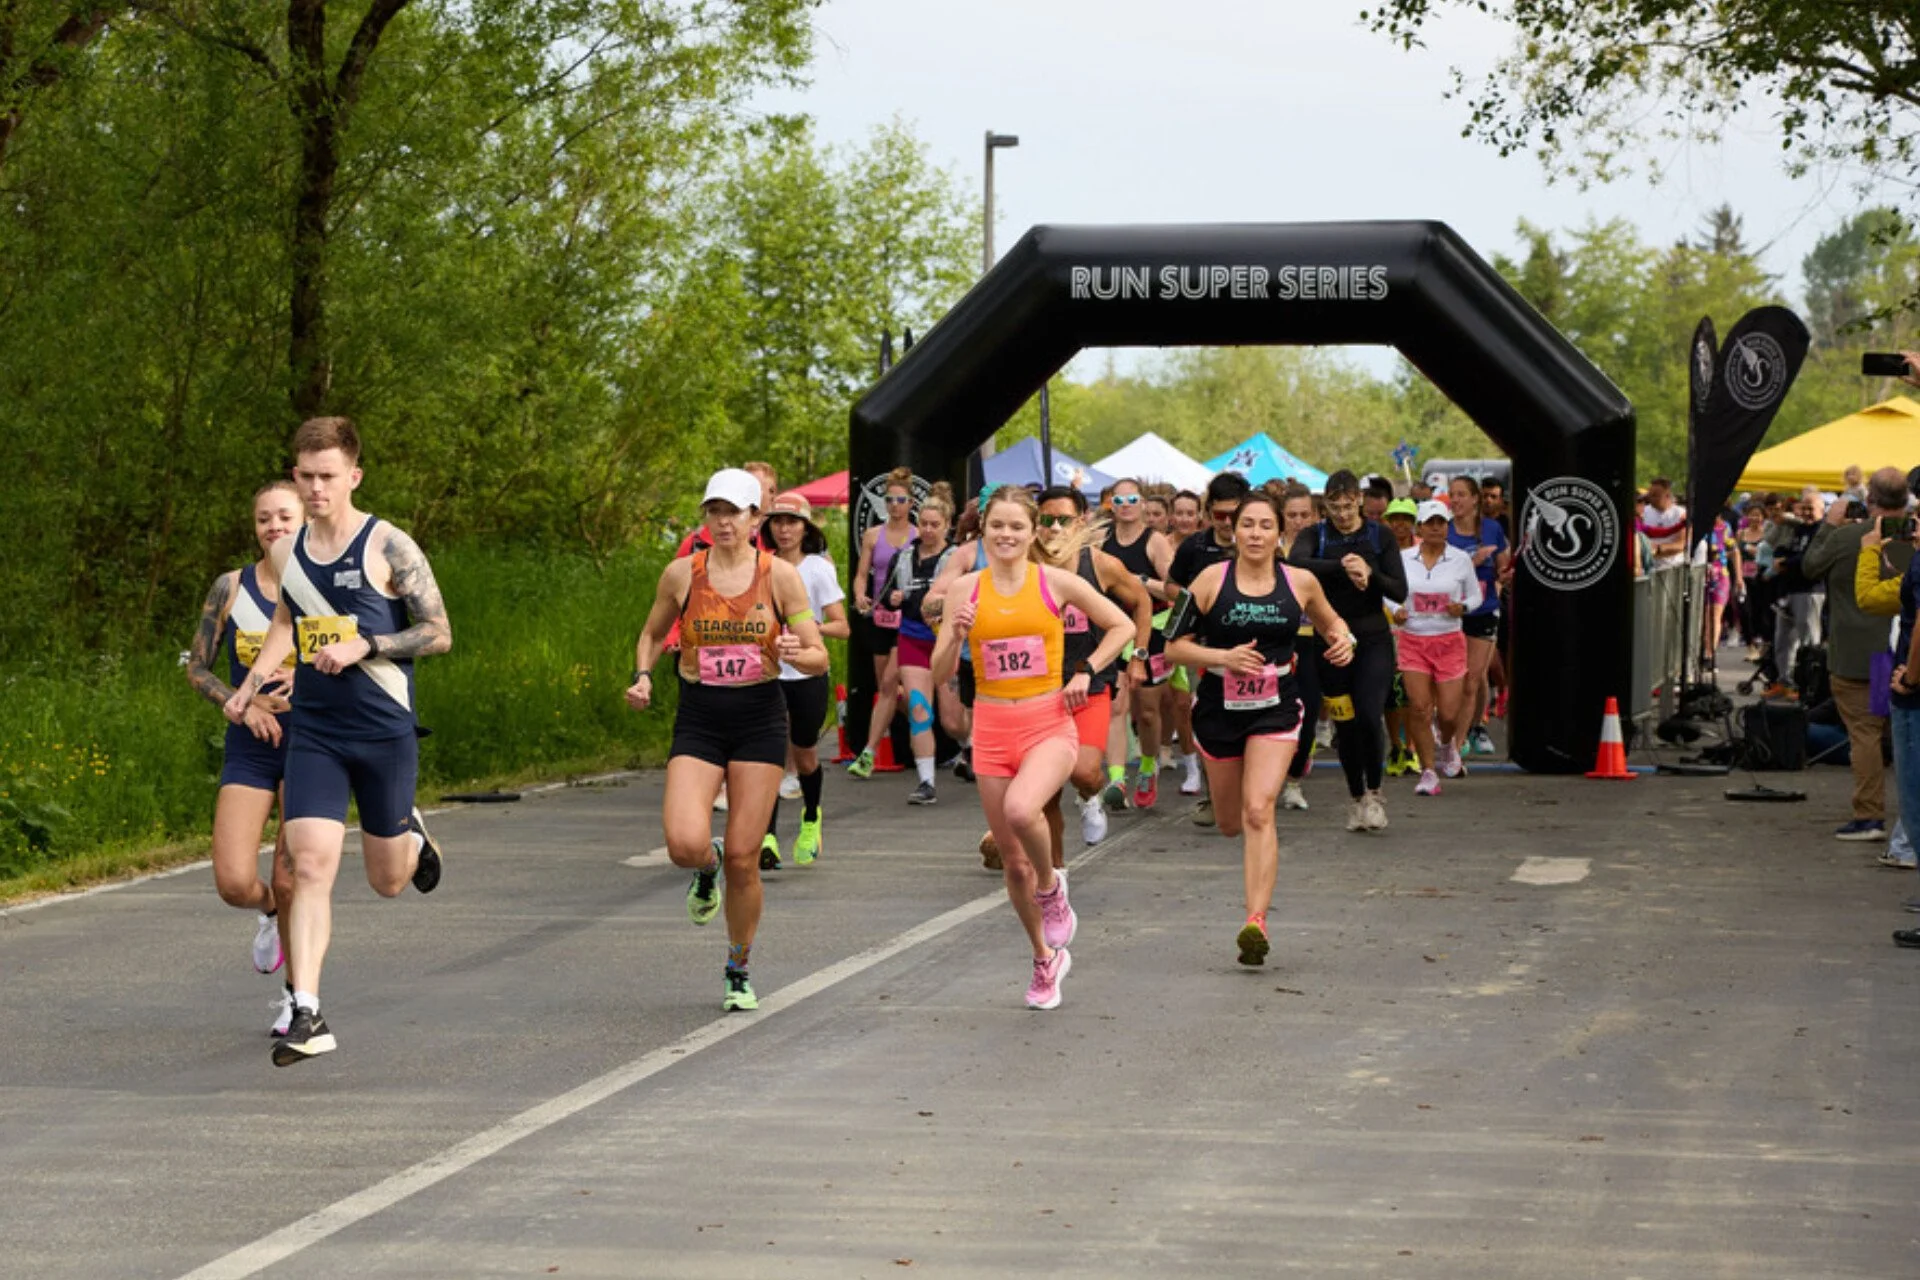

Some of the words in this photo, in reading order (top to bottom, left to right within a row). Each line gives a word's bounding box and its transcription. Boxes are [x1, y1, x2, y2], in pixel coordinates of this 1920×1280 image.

[1071, 266, 1150, 299] RUN
[1159, 265, 1270, 299] SUPER
[1278, 265, 1389, 299] SERIES
[694, 620, 766, 634] SIARGAO
[715, 659, 746, 678] 147
[998, 651, 1032, 673] 182
[1236, 679, 1266, 696] 247
